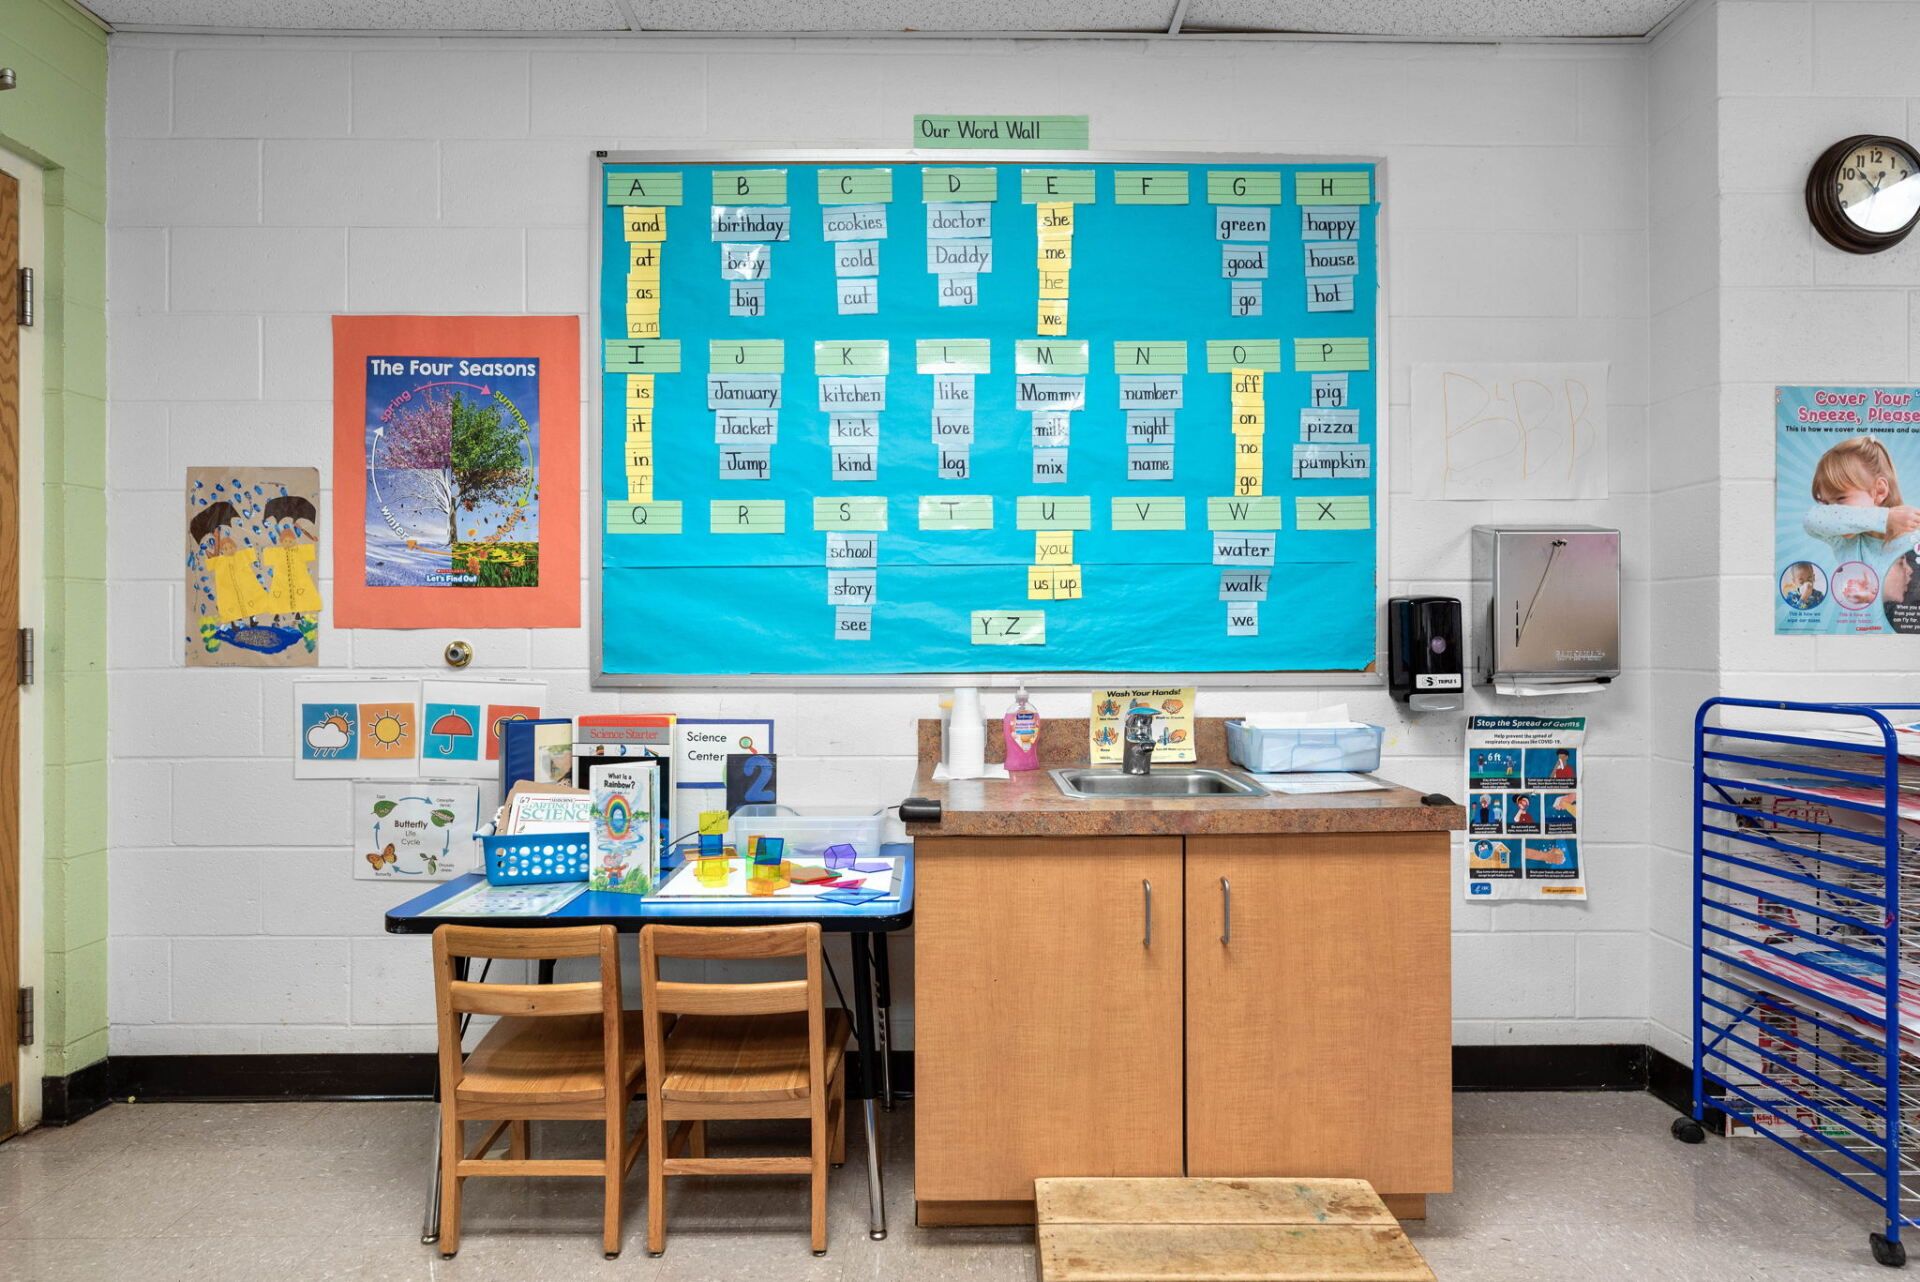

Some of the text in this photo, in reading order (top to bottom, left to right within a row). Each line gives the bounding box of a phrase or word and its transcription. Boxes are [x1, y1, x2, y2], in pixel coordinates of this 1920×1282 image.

[922, 120, 1040, 139] Our Word Wall
[1857, 156, 1865, 167] 11
[1871, 151, 1882, 163] 12
[1891, 157, 1895, 169] 1
[1843, 168, 1855, 180] 10
[629, 179, 645, 196] A
[738, 177, 749, 194] B
[841, 177, 853, 194] C
[949, 175, 961, 193] D
[1046, 177, 1058, 194] E
[1141, 178, 1153, 195] F
[1233, 178, 1246, 195] G
[1321, 179, 1333, 195] H
[632, 215, 660, 232] and
[718, 211, 783, 239] birthday
[828, 213, 882, 231] cookies
[933, 210, 986, 228] doctor
[1043, 208, 1070, 226] she
[1221, 219, 1265, 241] green
[1308, 213, 1355, 239] happy
[636, 247, 654, 266] at
[841, 249, 873, 268] cold
[936, 246, 988, 270] Daddy
[1045, 248, 1066, 260] me
[1310, 249, 1355, 267] house
[1228, 252, 1263, 276] good
[1045, 271, 1064, 288] he
[636, 286, 653, 300] as
[844, 285, 871, 304] cut
[943, 279, 972, 302] dog
[1315, 284, 1341, 302] hot
[736, 288, 758, 314] big
[1240, 294, 1256, 316] go
[632, 321, 658, 332] am
[1043, 313, 1061, 325] we
[628, 346, 644, 364] I
[736, 347, 744, 364] J
[843, 348, 853, 365] K
[944, 347, 955, 364] L
[1038, 347, 1053, 364] M
[1136, 347, 1149, 364] N
[1233, 346, 1246, 364] O
[1322, 344, 1333, 361] P
[371, 360, 535, 377] The Four Seasons
[636, 384, 650, 399] is
[939, 381, 969, 400] like
[1125, 383, 1178, 400] number
[1236, 375, 1259, 393] off
[714, 381, 777, 407] January
[824, 384, 881, 402] kitchen
[1022, 383, 1080, 403] Mommy
[1316, 381, 1342, 406] pig
[1815, 389, 1911, 405] Cover Your
[380, 390, 412, 423] spring
[492, 391, 530, 432] summer
[1240, 412, 1256, 425] on
[1798, 407, 1920, 424] Sneeze, Please
[633, 417, 645, 432] it
[720, 416, 773, 435] Jacket
[838, 418, 873, 437] kick
[937, 416, 970, 434] love
[1035, 417, 1066, 436] milk
[1132, 418, 1170, 442] night
[1307, 419, 1353, 440] pizza
[1240, 443, 1257, 454] no
[634, 452, 649, 466] in
[726, 452, 767, 478] Jump
[838, 454, 872, 472] kind
[943, 449, 965, 476] log
[1037, 461, 1063, 474] mix
[1132, 459, 1169, 470] name
[1300, 453, 1365, 477] pumpkin
[633, 475, 648, 493] if
[1240, 475, 1256, 495] go
[632, 506, 648, 525] Q
[739, 506, 749, 524] R
[840, 503, 850, 521] S
[940, 502, 959, 520] T
[1042, 503, 1054, 520] U
[1137, 504, 1149, 521] V
[1230, 503, 1248, 520] W
[1318, 503, 1335, 520] X
[381, 506, 409, 539] winter
[831, 540, 872, 558] school
[1040, 543, 1068, 562] you
[1218, 540, 1270, 557] water
[834, 575, 872, 602] story
[1034, 579, 1049, 590] us
[1060, 578, 1076, 597] up
[1225, 576, 1263, 592] walk
[841, 619, 866, 631] see
[1232, 615, 1254, 627] we
[1477, 720, 1495, 728] Stop
[1512, 720, 1541, 728] Spread
[591, 729, 656, 739] Science Starter
[687, 731, 726, 743] Science
[688, 750, 724, 761] Center
[1488, 753, 1501, 761] 6 ft
[604, 780, 635, 789] Rainbow?
[743, 755, 775, 801] 2
[521, 809, 588, 820] SCIENC
[394, 820, 428, 829] Butterfly
